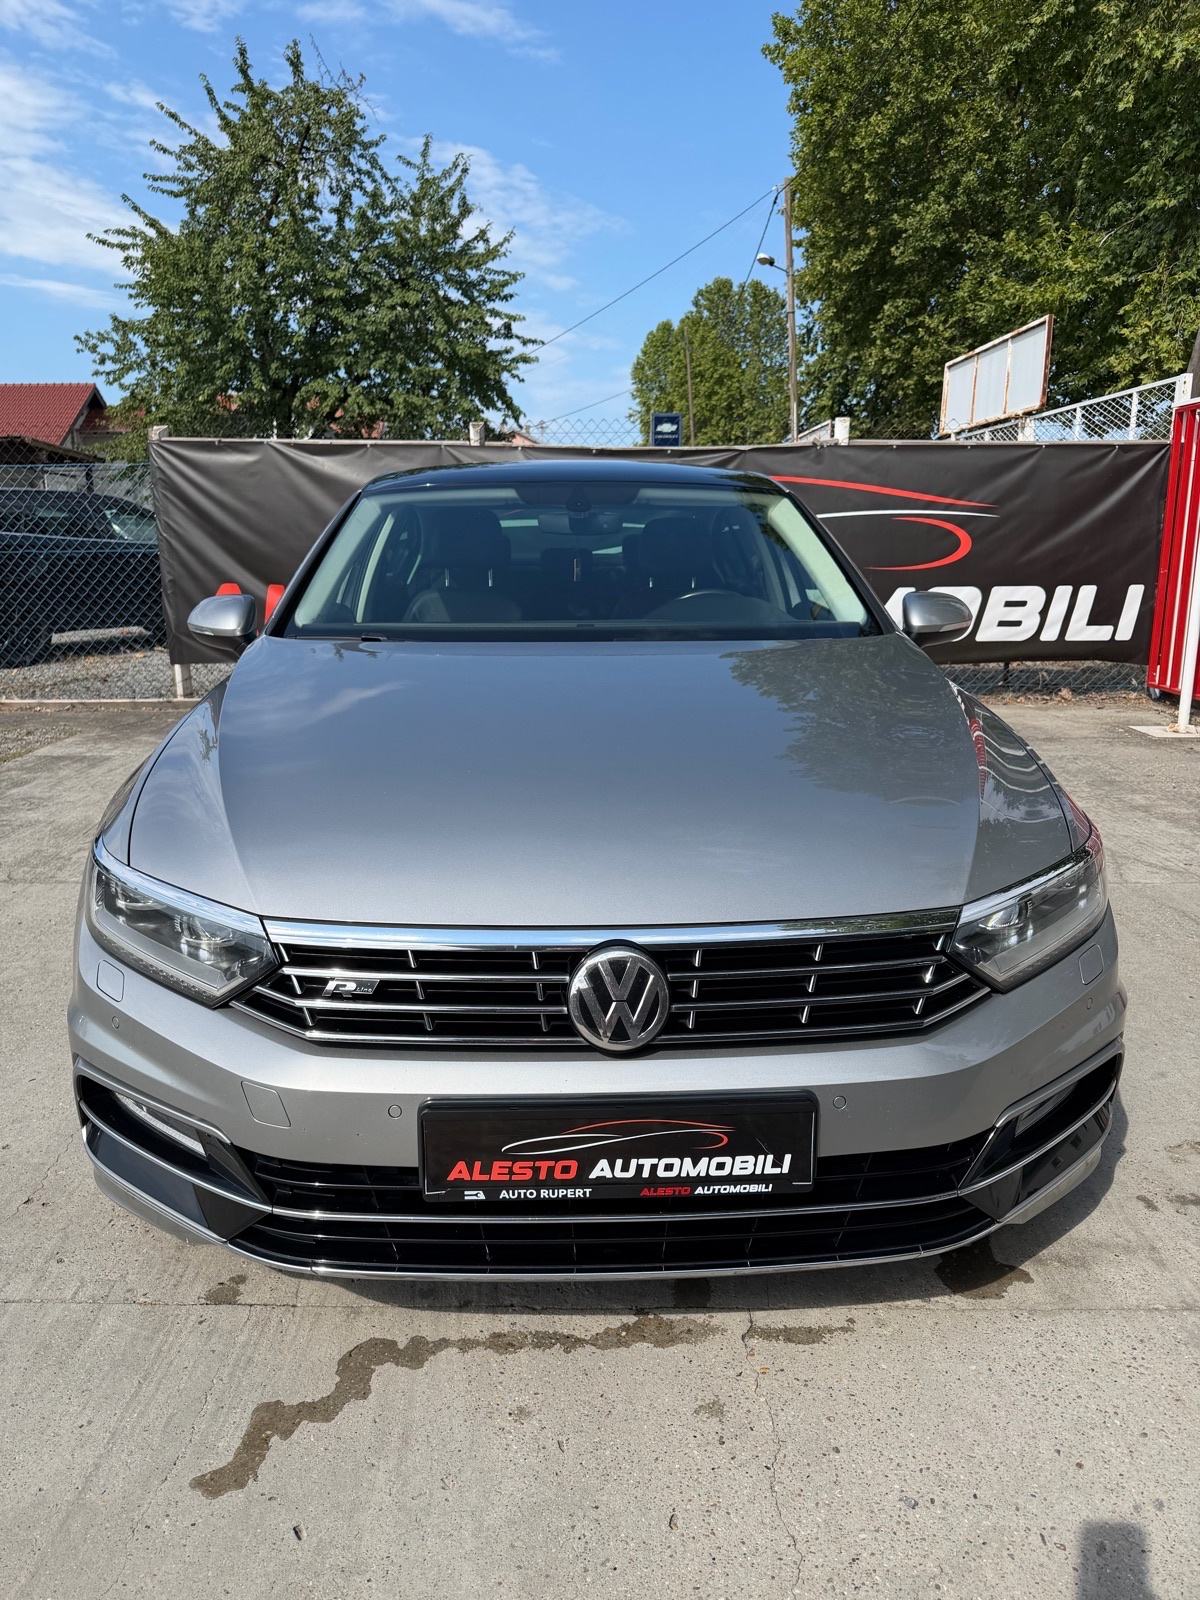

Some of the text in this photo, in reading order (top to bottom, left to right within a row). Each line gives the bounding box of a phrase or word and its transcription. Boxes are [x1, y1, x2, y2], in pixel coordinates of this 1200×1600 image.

[447, 1153, 792, 1181] ALESTO AUTOMOBILI
[499, 1188, 592, 1199] AUTO RUPERT
[640, 1183, 773, 1197] ALESTO AUTOMOBILI
